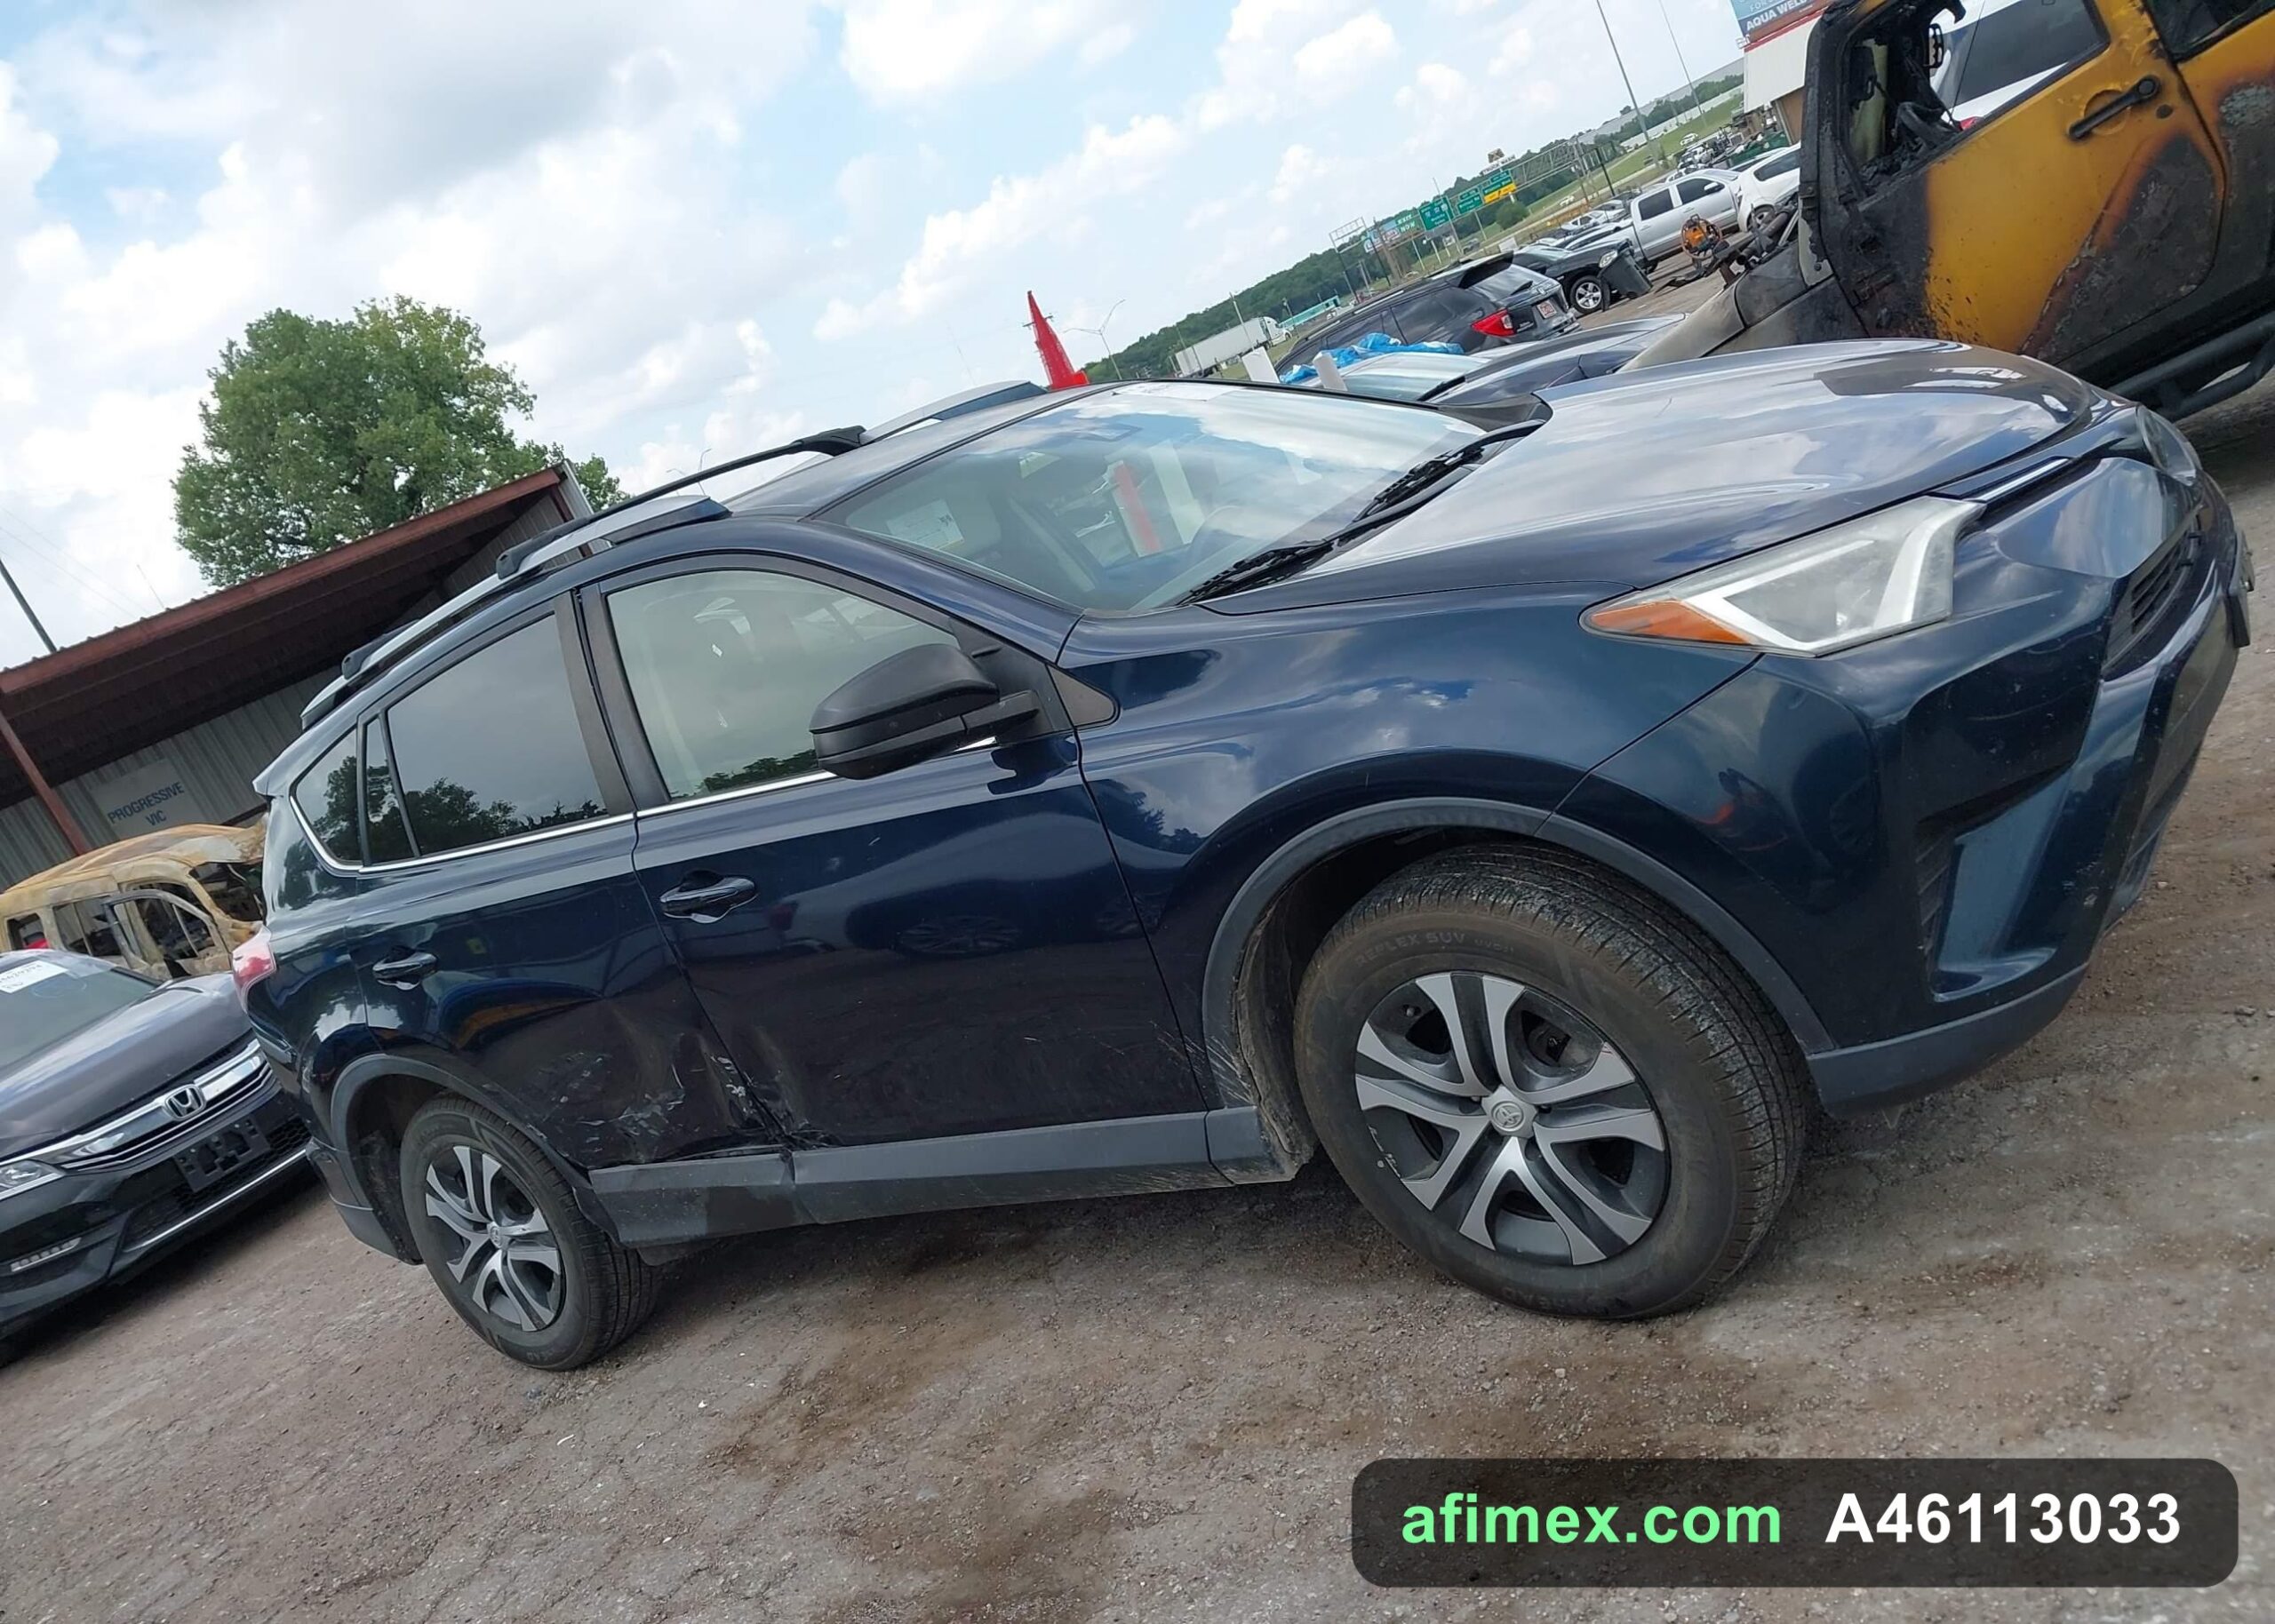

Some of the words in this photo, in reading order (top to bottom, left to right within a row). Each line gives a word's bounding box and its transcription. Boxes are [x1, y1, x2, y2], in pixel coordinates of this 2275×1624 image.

[1746, 10, 1777, 31] AQUA
[1400, 221, 1415, 232] NOW
[107, 782, 185, 824] PROGRESSIVE
[145, 810, 167, 826] VIC
[1425, 931, 1466, 943] SUV
